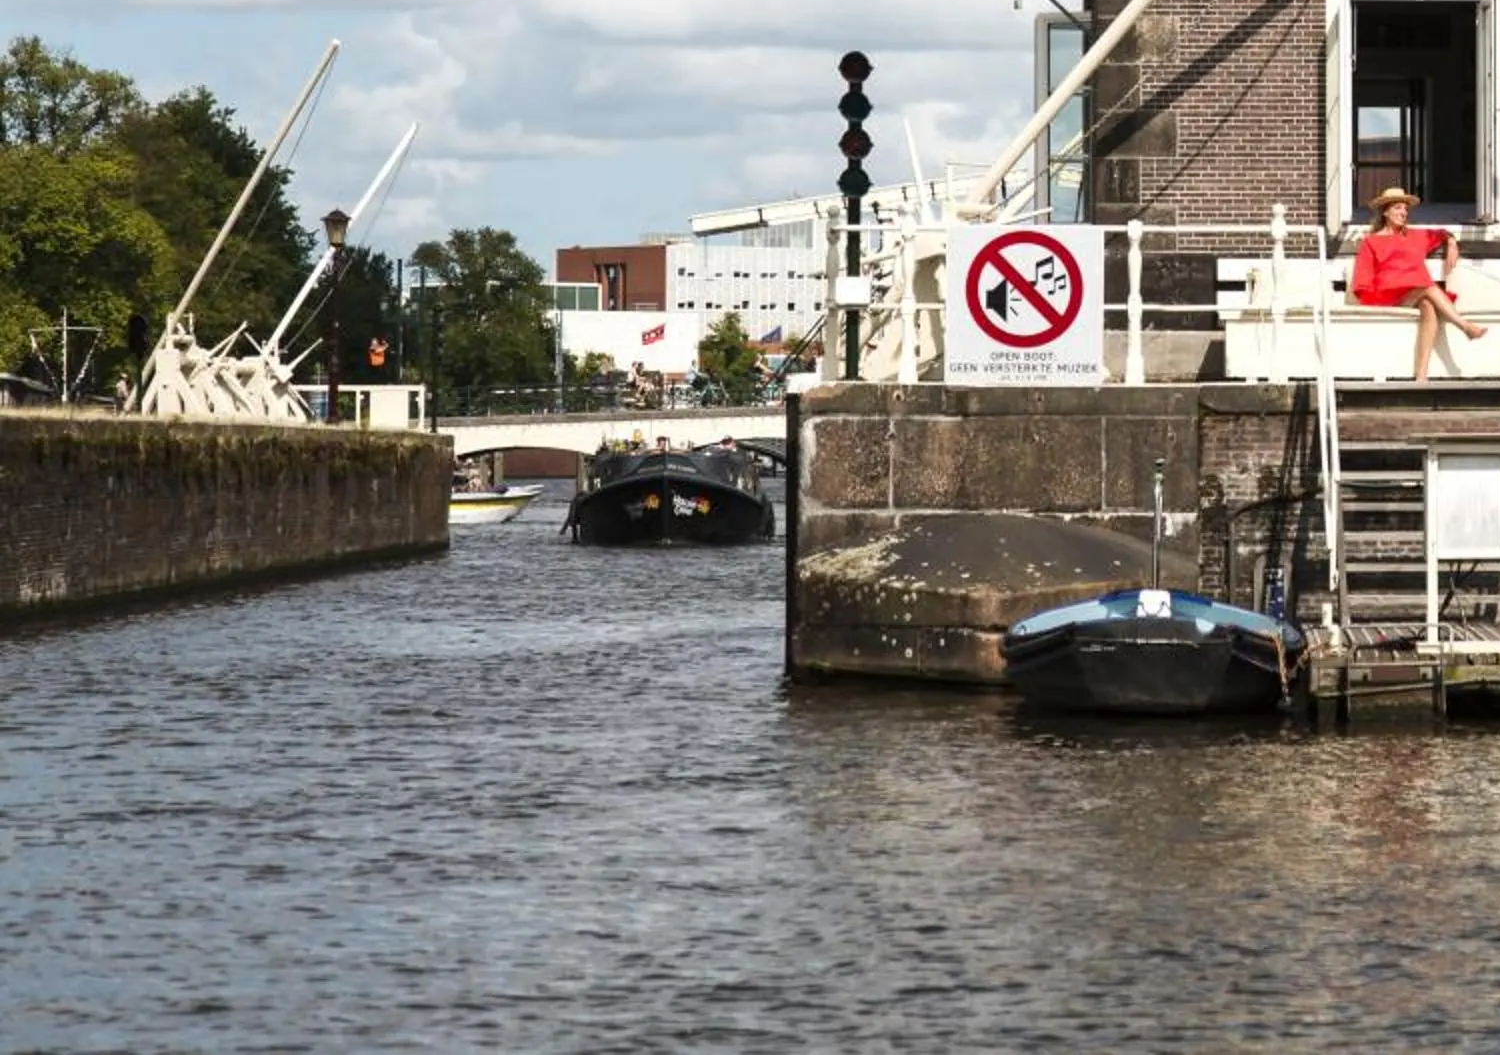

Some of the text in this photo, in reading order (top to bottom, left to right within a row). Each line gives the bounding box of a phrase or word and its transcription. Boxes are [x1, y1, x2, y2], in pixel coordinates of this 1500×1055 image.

[990, 352, 1020, 361] OPEN
[949, 363, 1098, 373] GEEN VERSTERKTE MUZIEK
